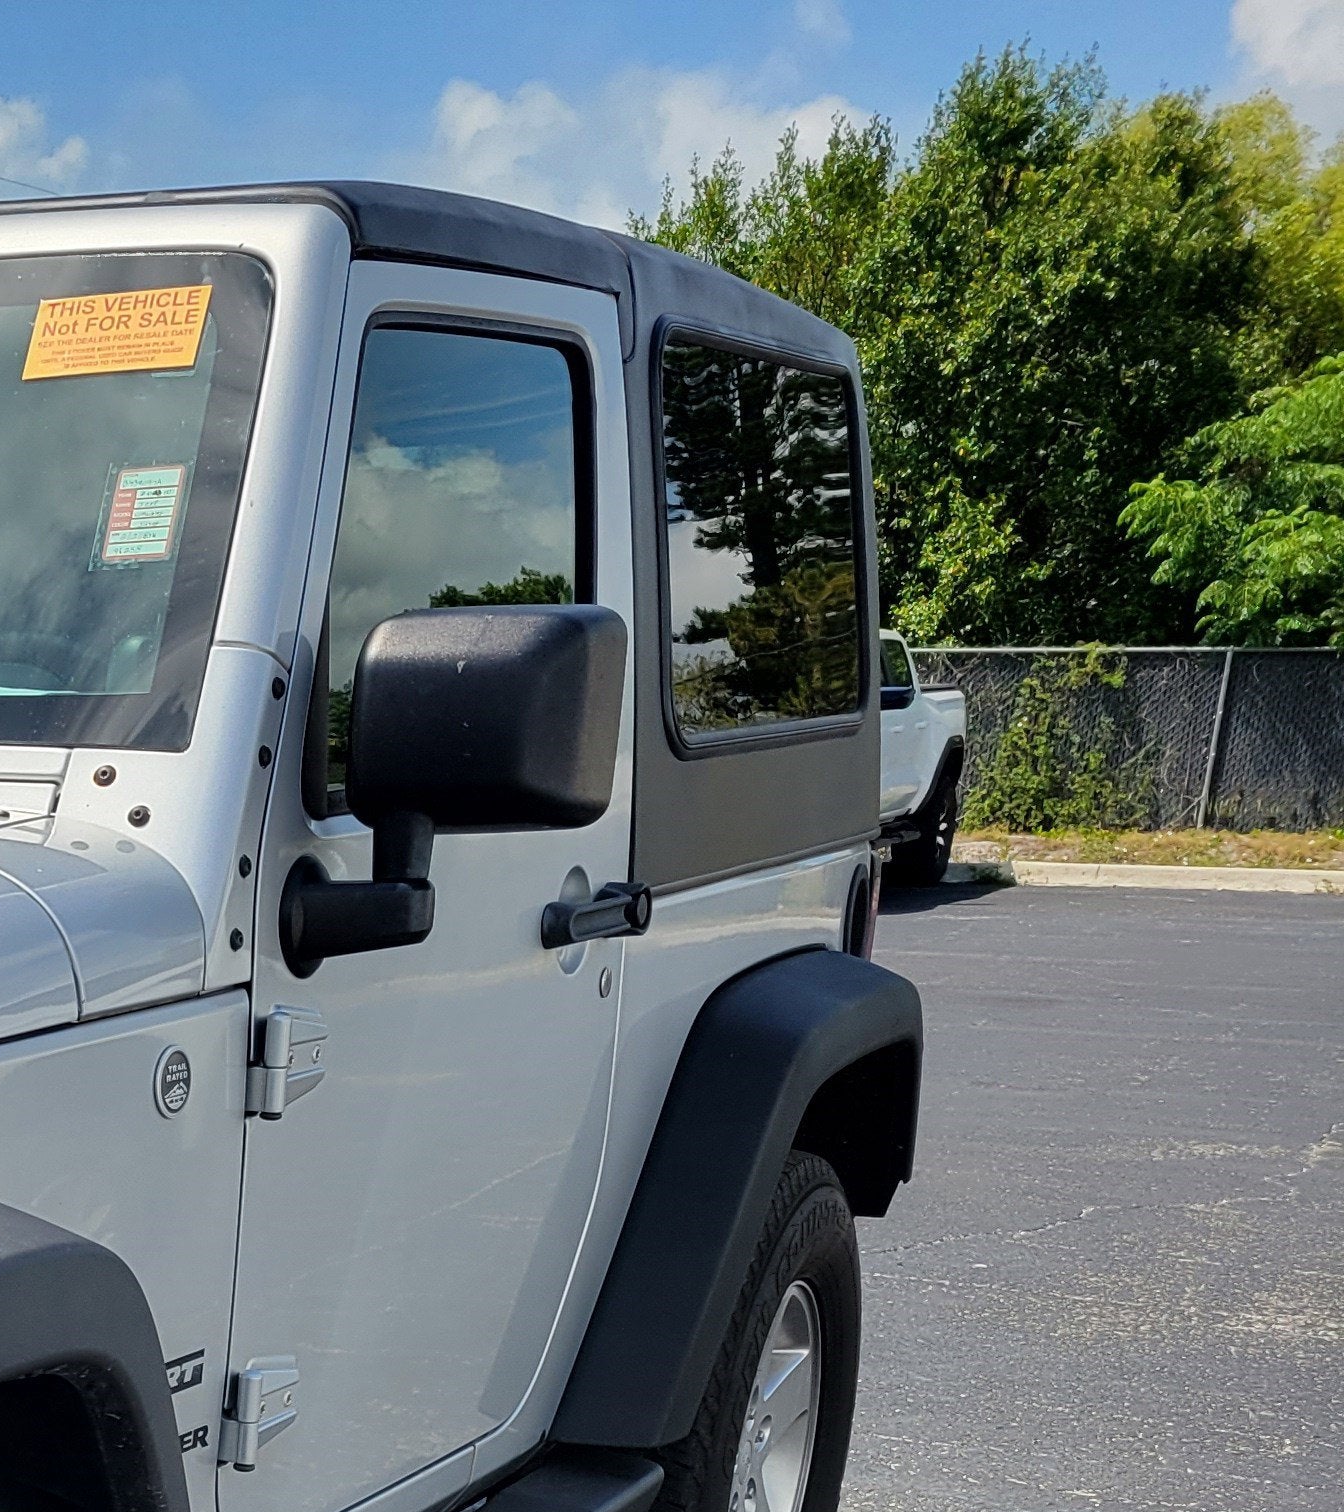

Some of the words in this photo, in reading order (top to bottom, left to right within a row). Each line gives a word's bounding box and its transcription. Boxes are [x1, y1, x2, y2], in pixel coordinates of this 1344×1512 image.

[47, 299, 97, 319] THIS
[104, 289, 202, 313] VEHICLE
[41, 320, 79, 338] Not
[85, 313, 131, 333] FOR
[138, 307, 200, 328] SALE
[57, 338, 74, 347] THE
[75, 335, 111, 346] DEALER
[112, 333, 132, 341] FOR
[132, 330, 170, 341] RESALE
[171, 327, 195, 337] DATE
[166, 1070, 189, 1083] RATED
[167, 1062, 188, 1073] TRAIL
